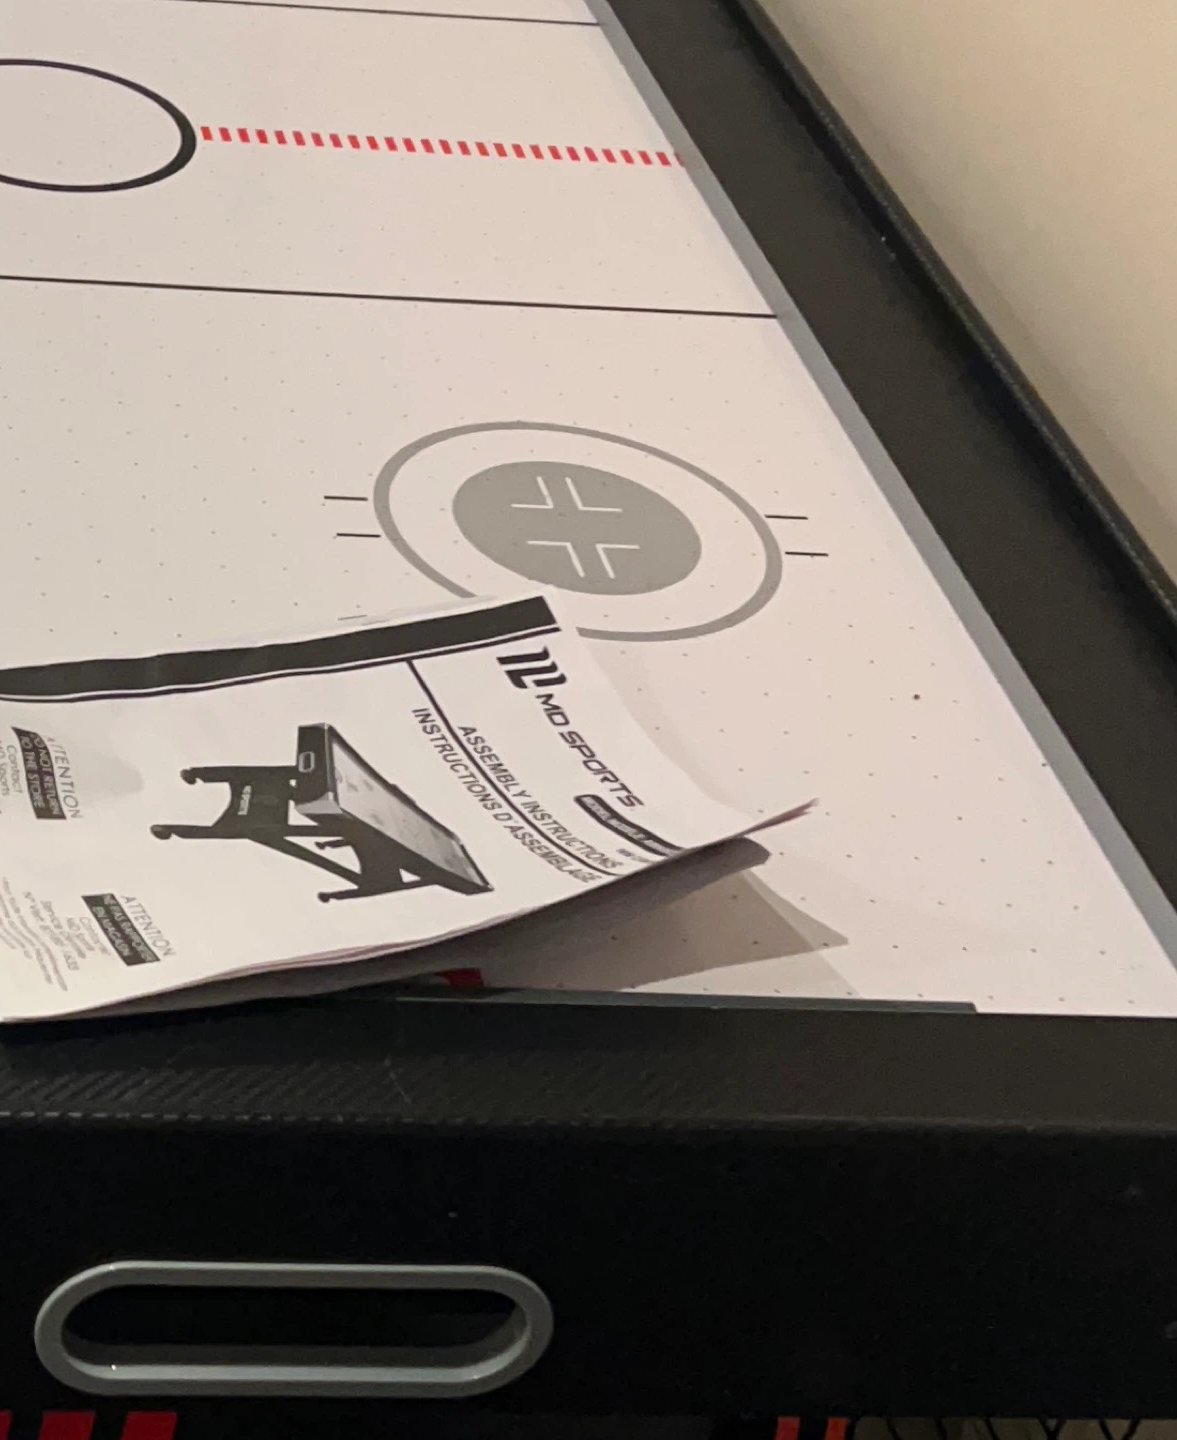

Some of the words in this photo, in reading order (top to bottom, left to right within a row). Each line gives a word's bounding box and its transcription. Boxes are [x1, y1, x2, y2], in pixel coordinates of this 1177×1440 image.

[412, 707, 502, 811] INSTRUCTIONS
[458, 725, 531, 799] ASSEMBLY
[520, 796, 624, 869] INSTRUCTIONS
[535, 693, 570, 727] MD
[558, 730, 644, 807] SPORTS
